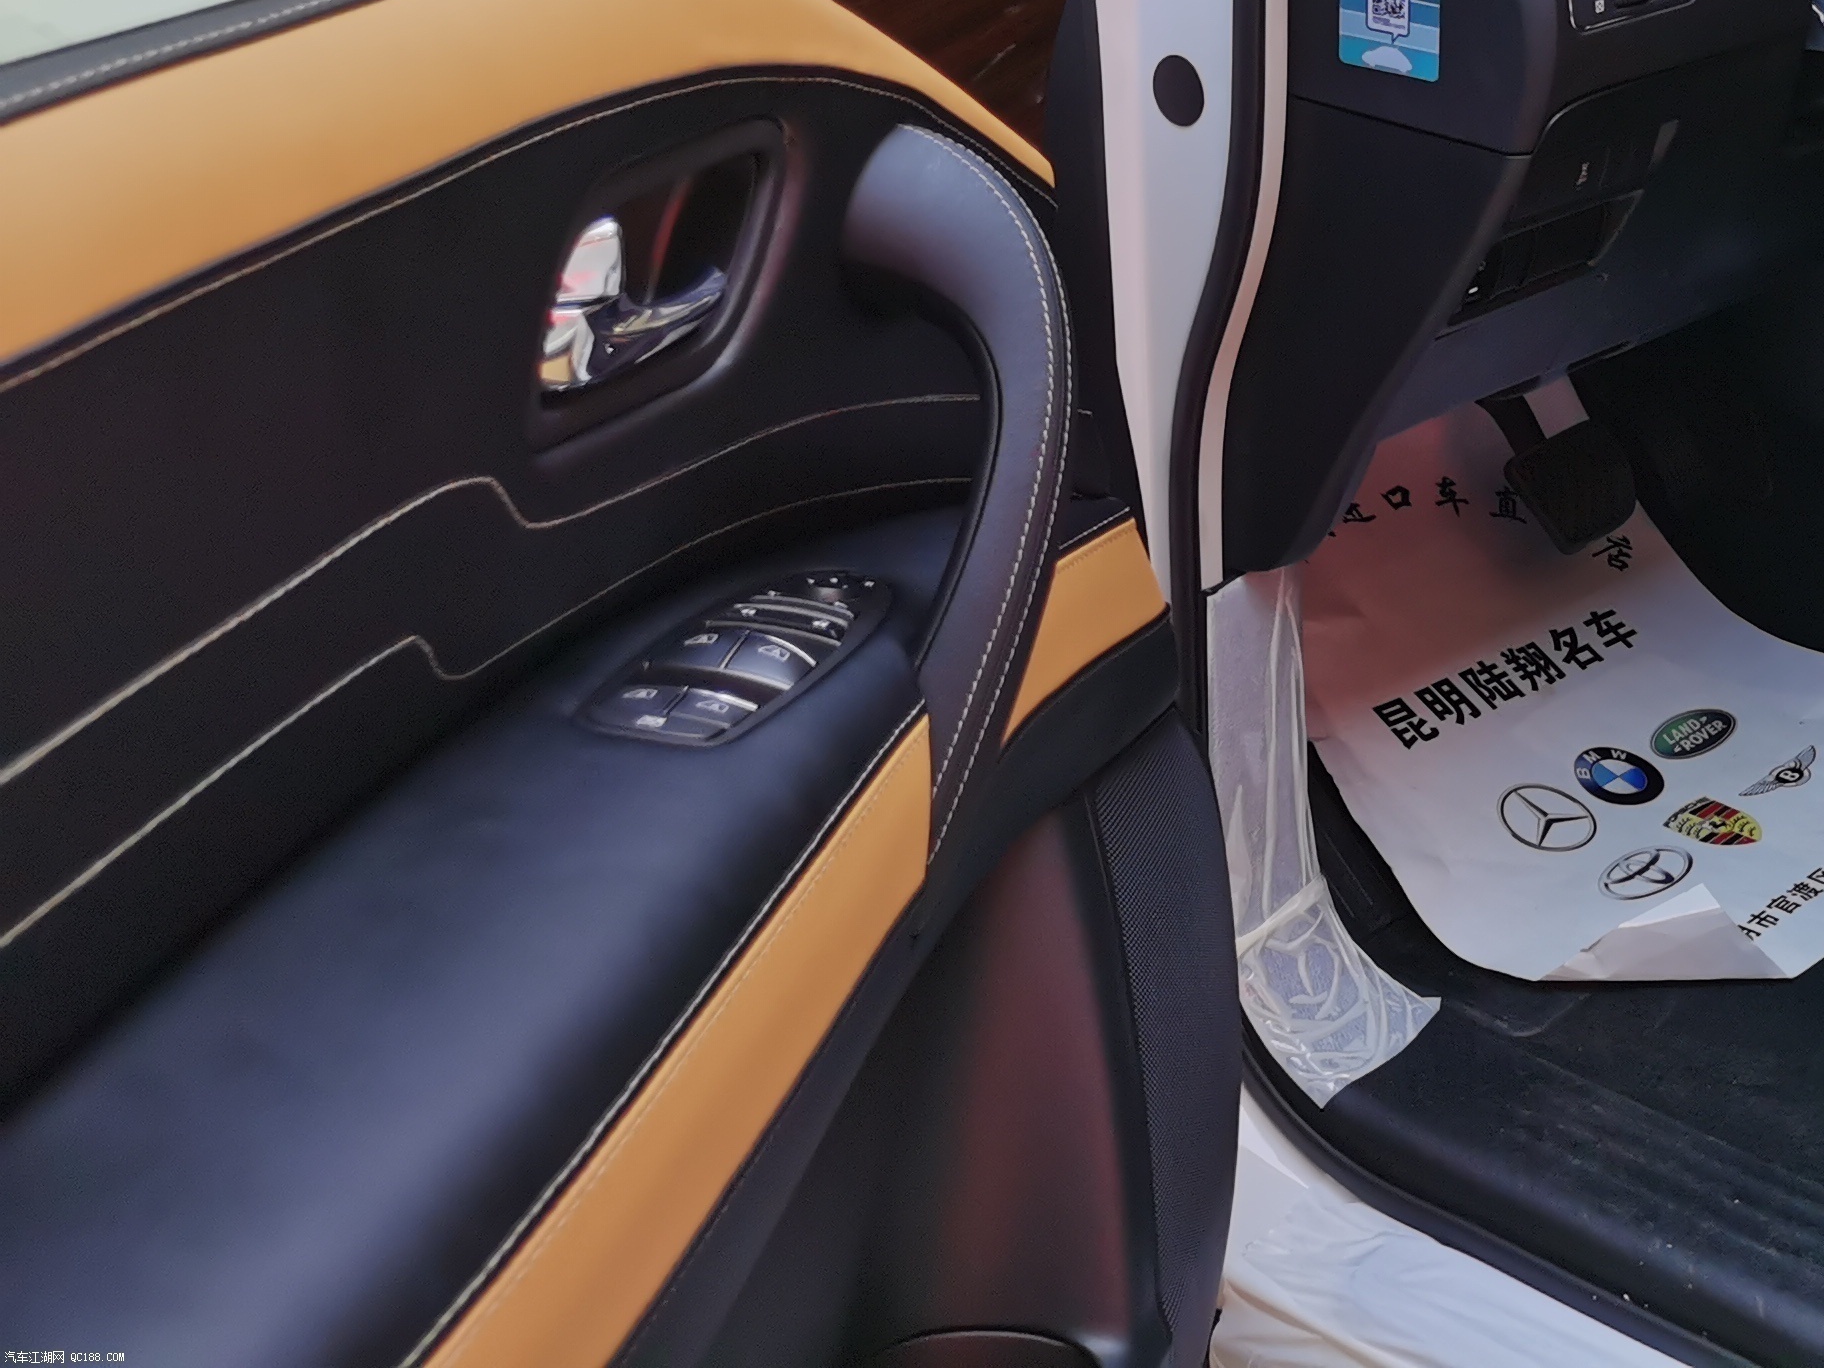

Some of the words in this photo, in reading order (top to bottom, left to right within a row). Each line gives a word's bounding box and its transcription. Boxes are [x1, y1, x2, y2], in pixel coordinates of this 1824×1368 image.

[1372, 609, 1638, 749] 昆明陆翔名车
[1662, 718, 1701, 745] LAND
[1680, 719, 1728, 752] ROVER
[1576, 749, 1627, 780] BMW
[1782, 768, 1800, 782] B
